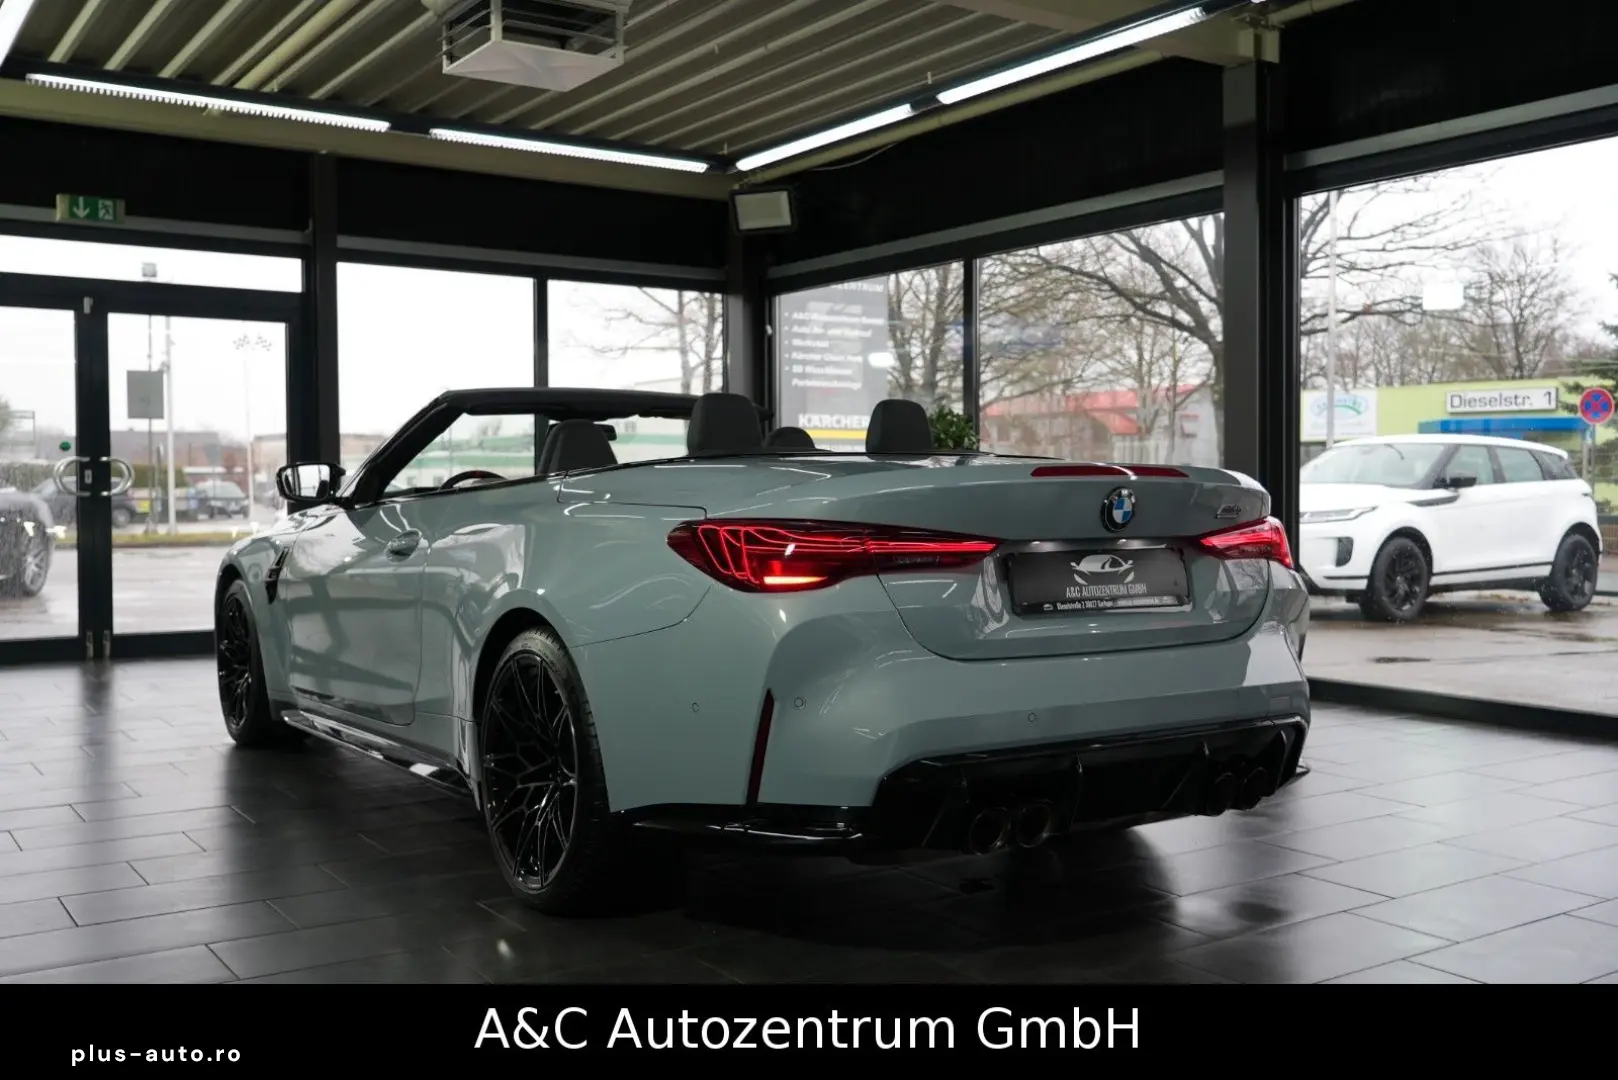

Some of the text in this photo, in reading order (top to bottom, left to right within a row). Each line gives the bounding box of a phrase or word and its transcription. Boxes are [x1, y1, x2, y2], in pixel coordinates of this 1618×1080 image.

[1450, 391, 1552, 409] Dieselstr. 1
[1066, 586, 1081, 598] A&C
[1082, 584, 1127, 597] AUTOZENTRUM
